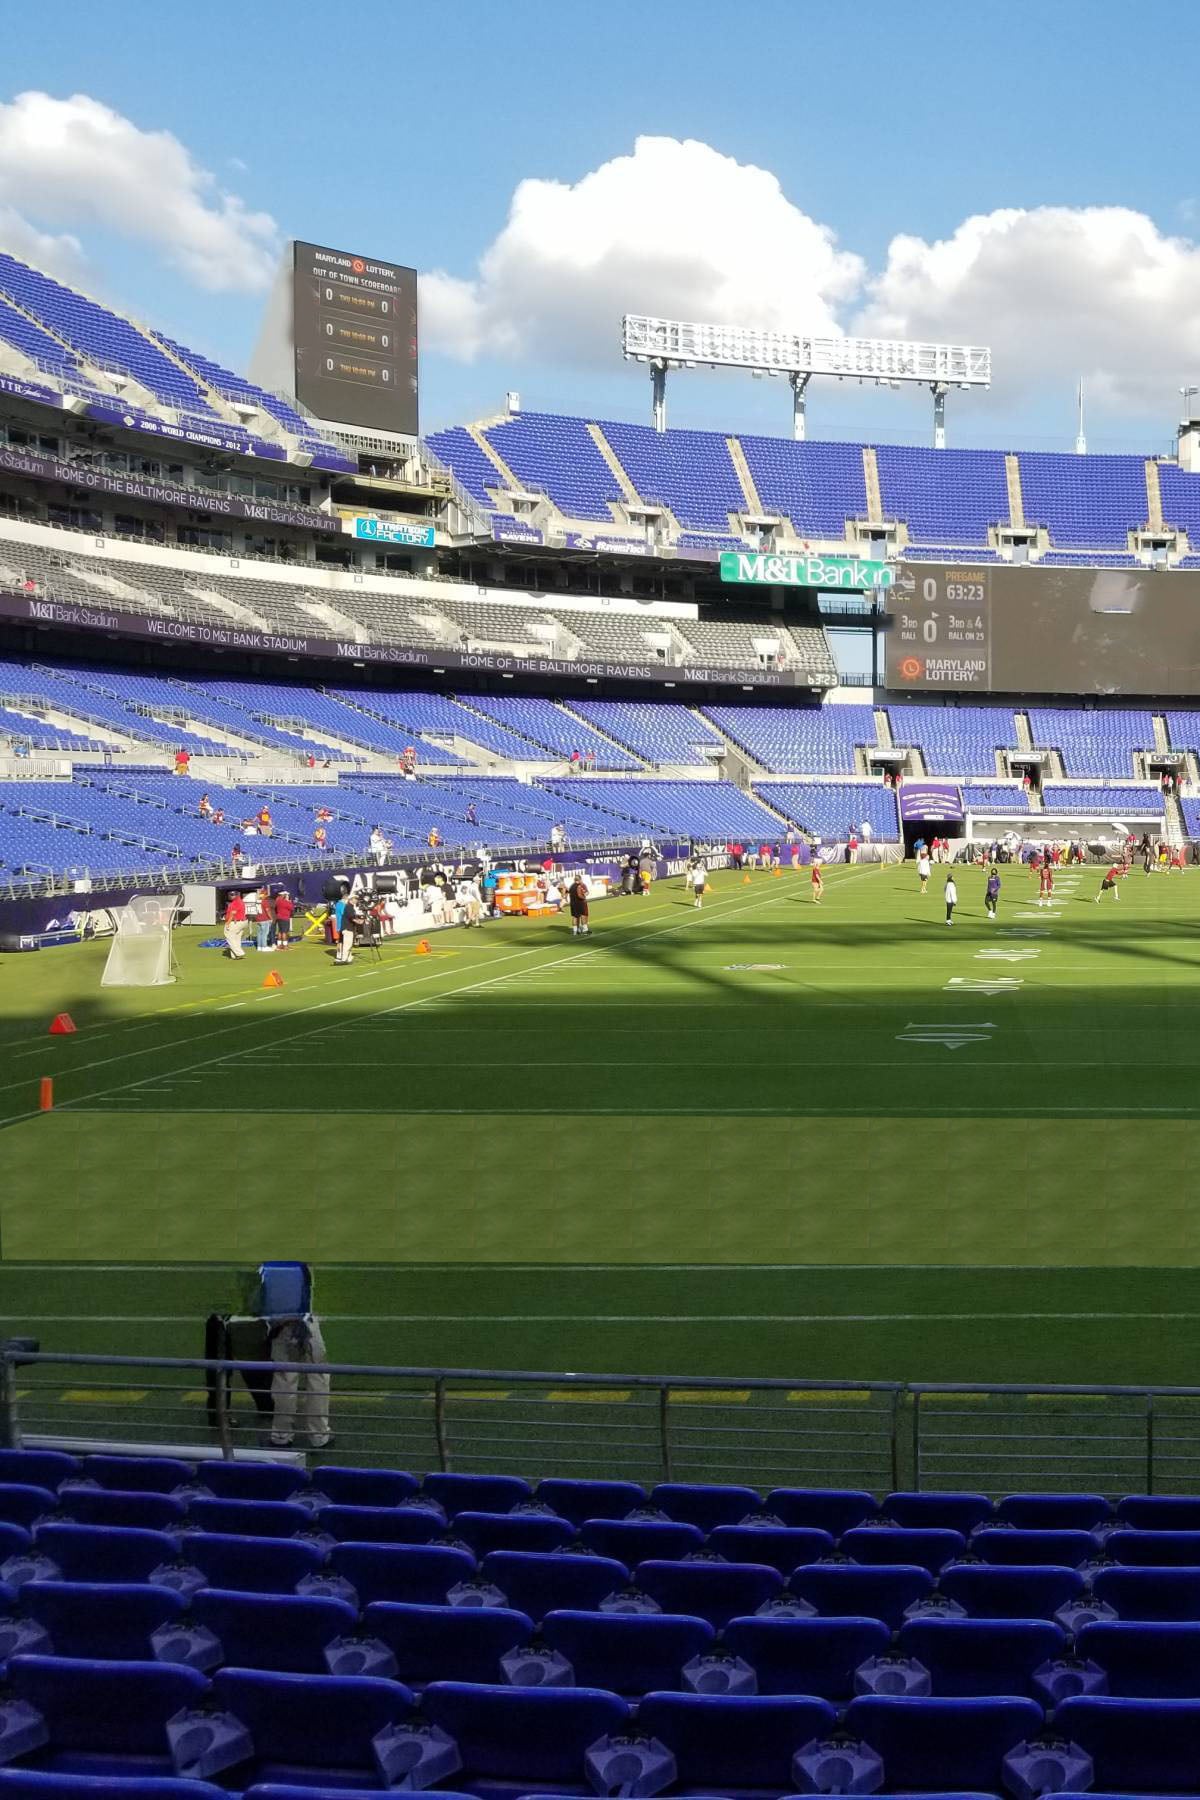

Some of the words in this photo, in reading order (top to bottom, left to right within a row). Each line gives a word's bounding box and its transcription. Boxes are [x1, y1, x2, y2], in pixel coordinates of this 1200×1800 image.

[315, 252, 352, 267] MARYLAND
[366, 264, 394, 278] LOTTERY
[313, 267, 327, 277] OUT
[328, 271, 338, 280] OF
[339, 273, 359, 285] TOWN
[360, 278, 402, 294] SCOREBOARD
[325, 288, 333, 300] 0
[381, 301, 388, 313] 0
[326, 323, 333, 335] 0
[381, 335, 388, 347] 0
[326, 358, 333, 370] 0
[382, 369, 388, 381] 0
[140, 420, 157, 431] 2000
[161, 425, 185, 437] WORLD
[186, 431, 222, 446] CHAMPIONS
[225, 441, 241, 451] 2012
[3, 451, 44, 475] Stadium
[54, 466, 85, 484] HOME
[86, 474, 102, 487] OF
[102, 477, 124, 493] THE
[126, 482, 187, 505] BALTIMORE
[189, 494, 231, 513] RAVENS
[244, 503, 271, 520] M&T
[270, 508, 296, 523] Bank
[296, 512, 336, 531] Stadium
[376, 521, 430, 535] STRATEGIC
[376, 530, 429, 544] FACTORY
[737, 554, 805, 583] M&T
[807, 558, 869, 587] Bank
[944, 571, 986, 583] PREGAME
[923, 578, 937, 601] 0
[946, 585, 984, 600] 63:23
[29, 601, 56, 619] M&T
[56, 605, 80, 623] Bank
[80, 608, 119, 629] Stadium
[902, 615, 918, 629] 3RD
[948, 615, 965, 629] 3RD
[974, 615, 982, 629] 4
[147, 619, 196, 639] WELCOME
[198, 627, 211, 641] TO
[212, 629, 231, 643] M&T
[233, 632, 261, 647] BANK
[263, 636, 307, 651] STADIUM
[902, 631, 916, 641] BALL
[923, 620, 937, 643] 0
[948, 631, 964, 641] BALL
[965, 631, 975, 641] ON
[336, 643, 364, 658] M&T
[363, 646, 389, 660] Bank
[389, 648, 428, 664] Stadium
[460, 655, 494, 667] HOME
[496, 658, 512, 669] OF
[516, 659, 536, 671] THE
[539, 660, 604, 675] BALTIMORE
[606, 665, 651, 678] RAVENS
[926, 659, 986, 671] MARYLAND
[683, 668, 711, 681] M&T
[711, 670, 737, 682] Bank
[737, 671, 780, 685] Stadium
[926, 671, 974, 681] LOTTERY
